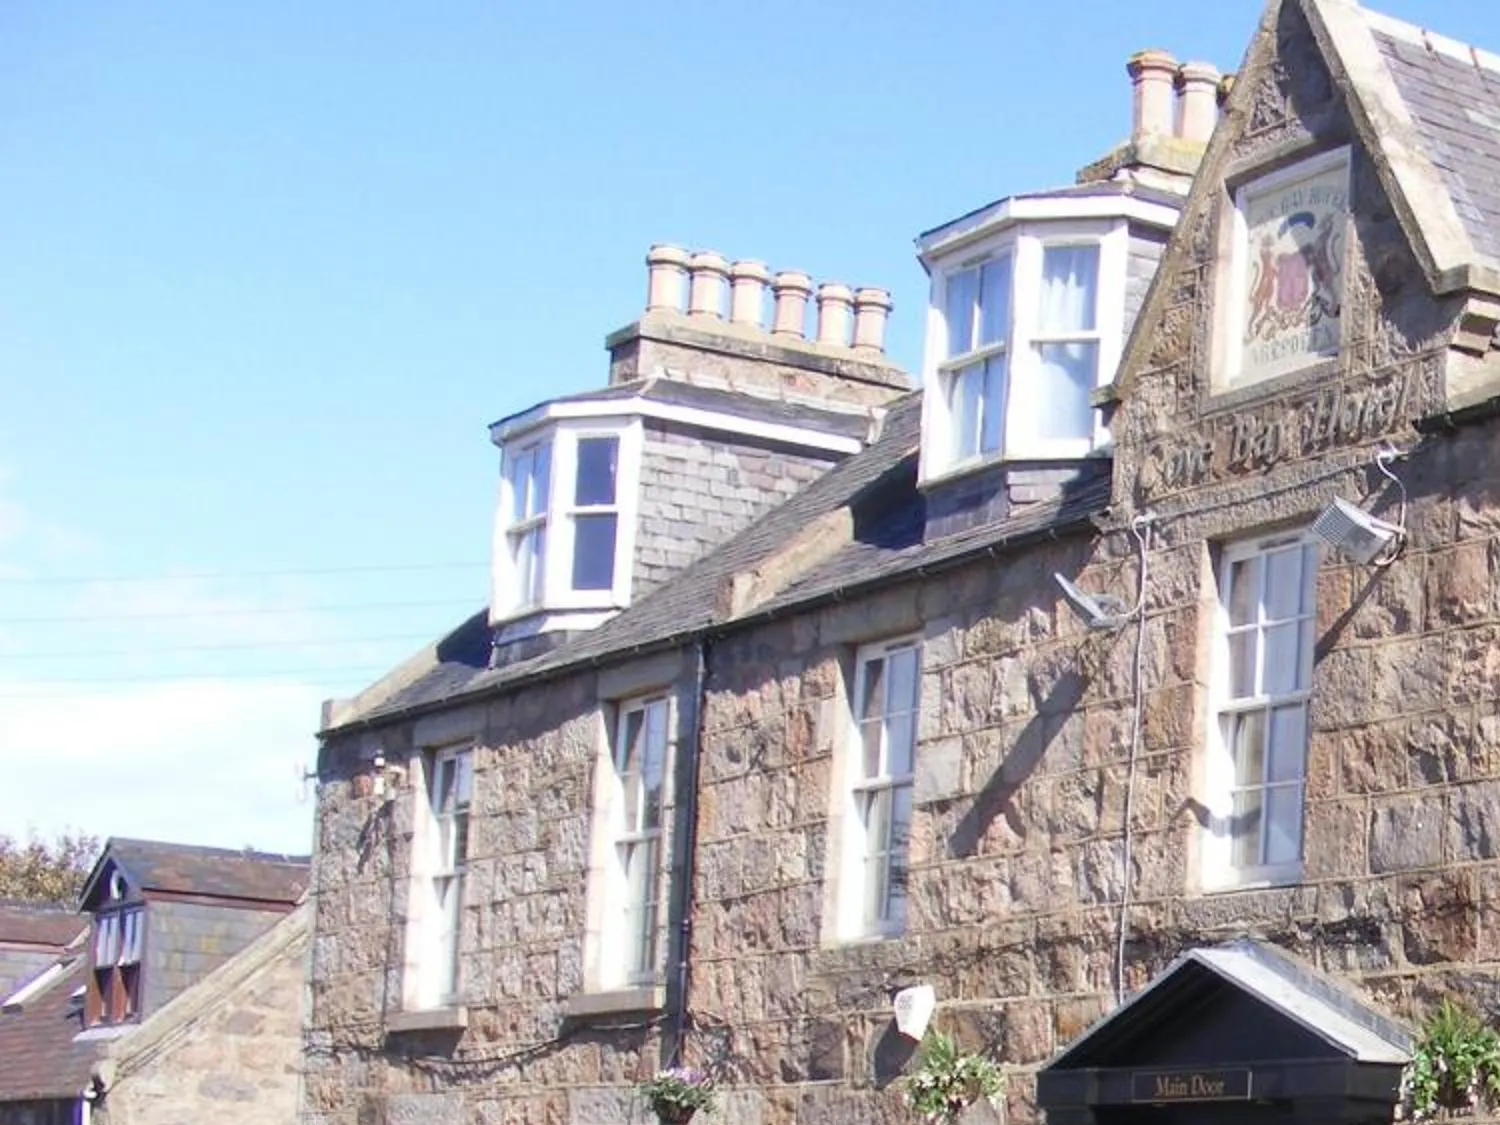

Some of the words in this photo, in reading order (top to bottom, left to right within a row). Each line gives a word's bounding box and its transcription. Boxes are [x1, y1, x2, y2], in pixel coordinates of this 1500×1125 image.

[1300, 368, 1412, 452] Hotel
[1155, 1076, 1188, 1097] Main
[1191, 1074, 1225, 1097] Door
